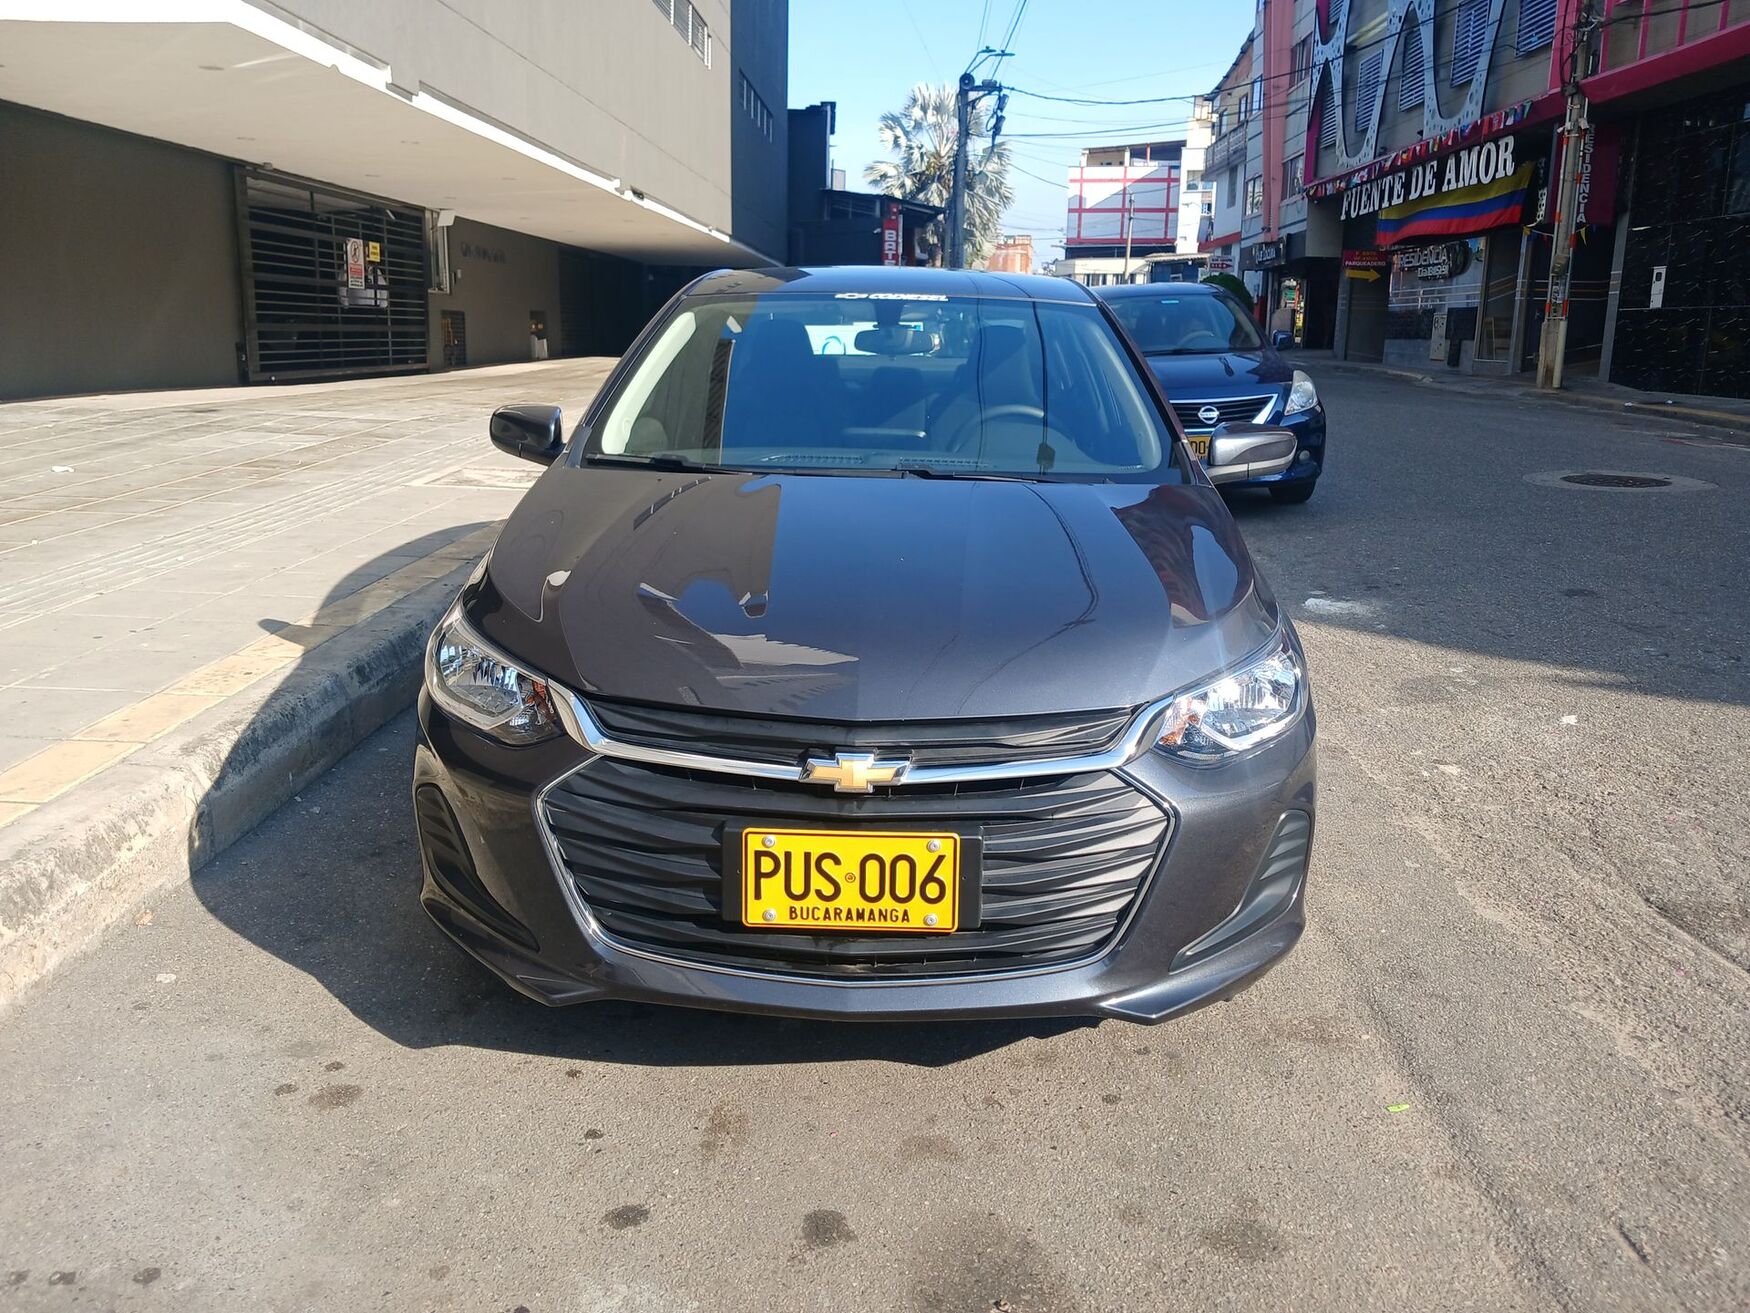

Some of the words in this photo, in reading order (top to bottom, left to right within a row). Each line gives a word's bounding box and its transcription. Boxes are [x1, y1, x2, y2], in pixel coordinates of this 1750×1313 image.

[1340, 171, 1406, 221] FUENTE
[1409, 159, 1438, 201] DE
[1442, 135, 1515, 193] AMOR
[753, 850, 842, 902] PUS
[858, 853, 946, 905] 006
[789, 906, 910, 923] BUCARAMANGA
